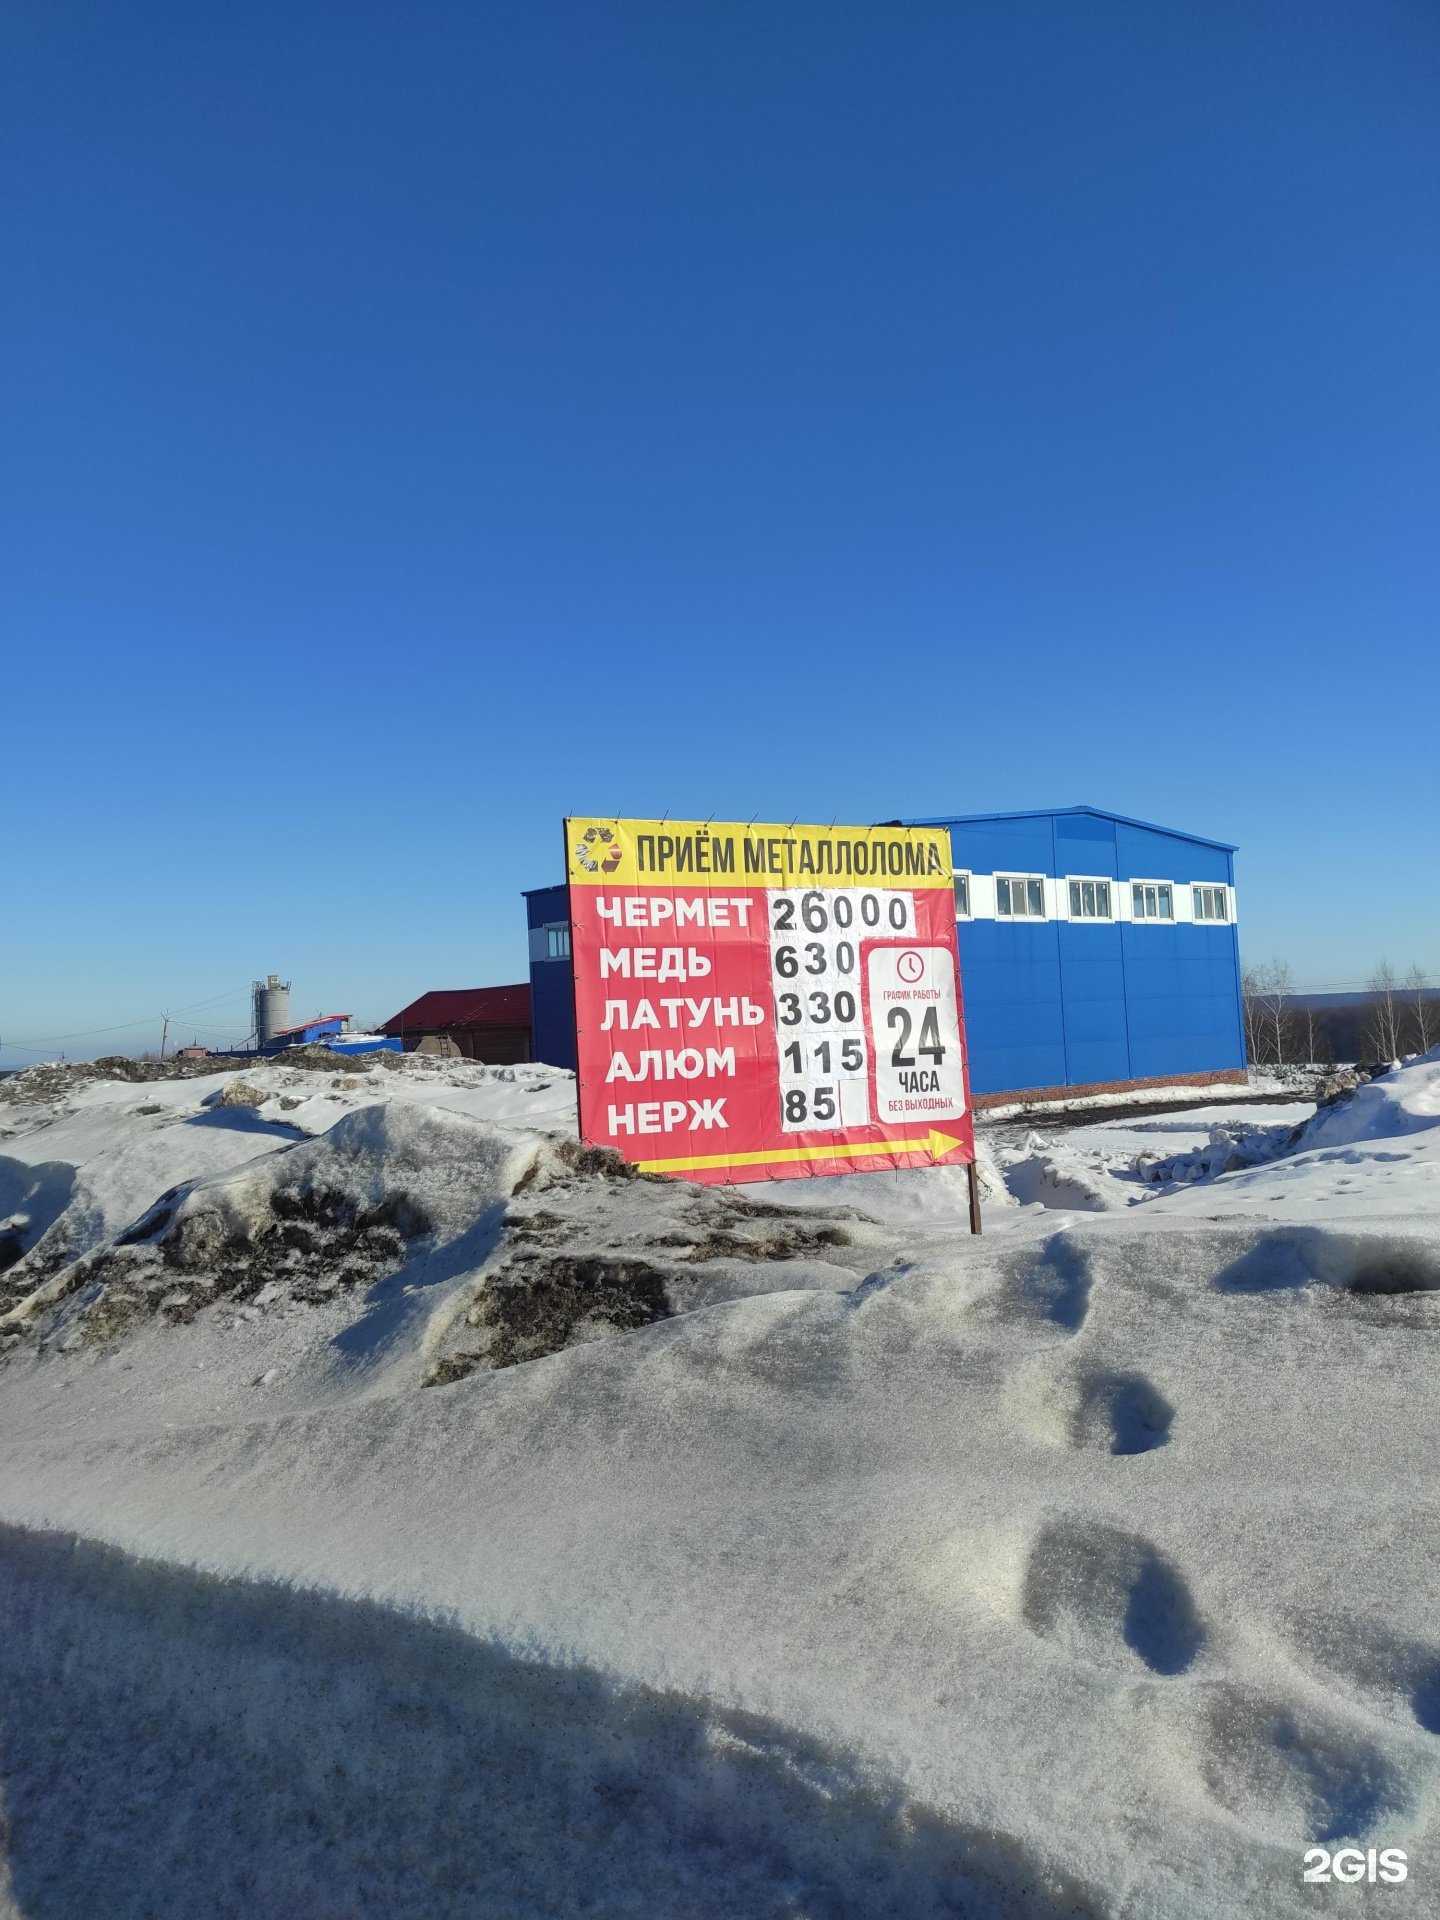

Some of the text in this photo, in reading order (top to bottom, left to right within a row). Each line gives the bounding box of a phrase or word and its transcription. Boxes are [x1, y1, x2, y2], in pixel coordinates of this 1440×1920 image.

[637, 830, 943, 875] ПРИЁМ МЕТАЛЛОЛОМА
[596, 891, 908, 933] ЧЕРМЕТ 26000
[600, 941, 855, 982] МЕДЬ 630
[600, 991, 856, 1031] ЛАТУНЬ 330
[883, 989, 941, 1001] ГРАФИК РАБОТЫ
[887, 1006, 945, 1067] 24
[605, 1039, 864, 1083] АЛЮМ 115
[898, 1070, 940, 1093] ЧАСА
[607, 1087, 836, 1136] НЕРЖ 85
[888, 1097, 953, 1112] БЕЗ ВЫХОДНЫХ
